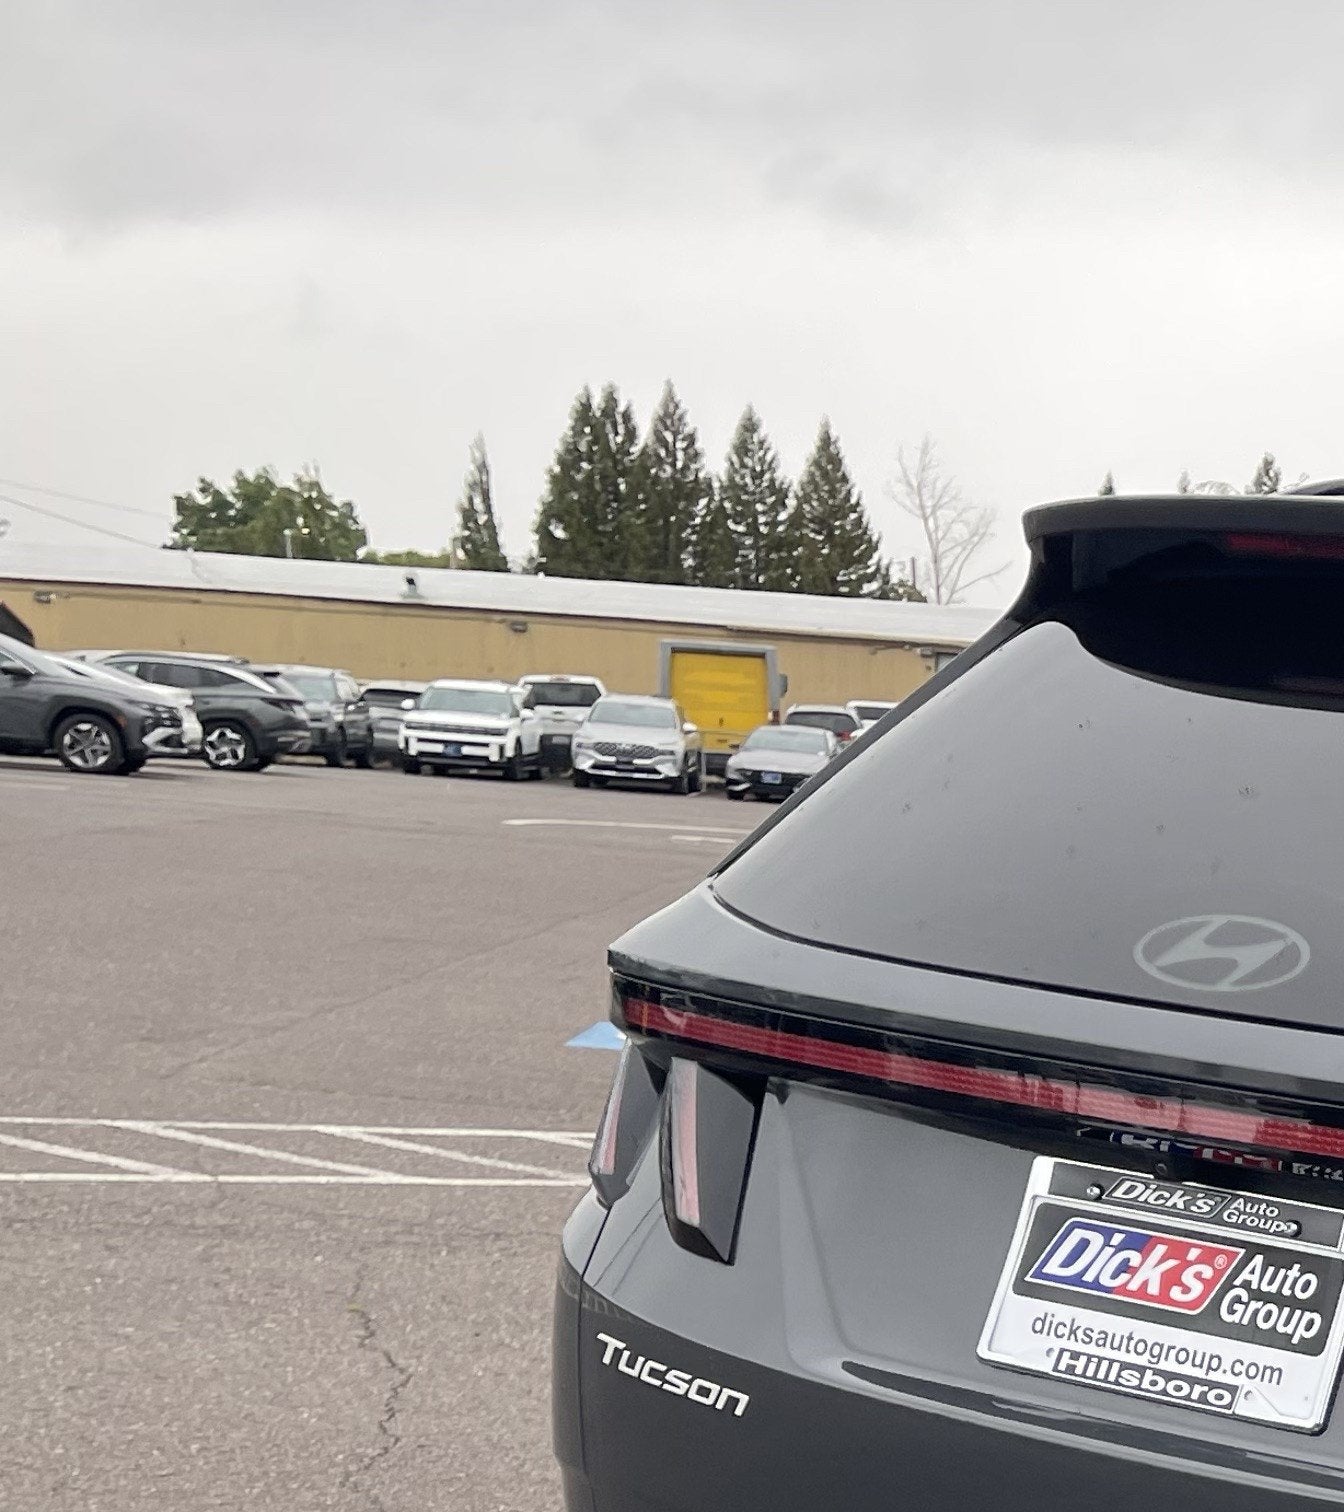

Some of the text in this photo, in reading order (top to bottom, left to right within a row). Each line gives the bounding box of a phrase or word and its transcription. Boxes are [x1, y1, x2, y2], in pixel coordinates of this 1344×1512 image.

[1111, 1180, 1216, 1214] Dick's
[1222, 1209, 1289, 1234] Group
[1230, 1197, 1280, 1218] Auto
[1041, 1227, 1216, 1302] Dick's
[1233, 1253, 1319, 1300] Auto
[1219, 1287, 1323, 1344] Group
[596, 1332, 750, 1417] Tucson
[1031, 1312, 1284, 1386] dicksautogroup.com
[1055, 1349, 1233, 1407] Hillsboro
